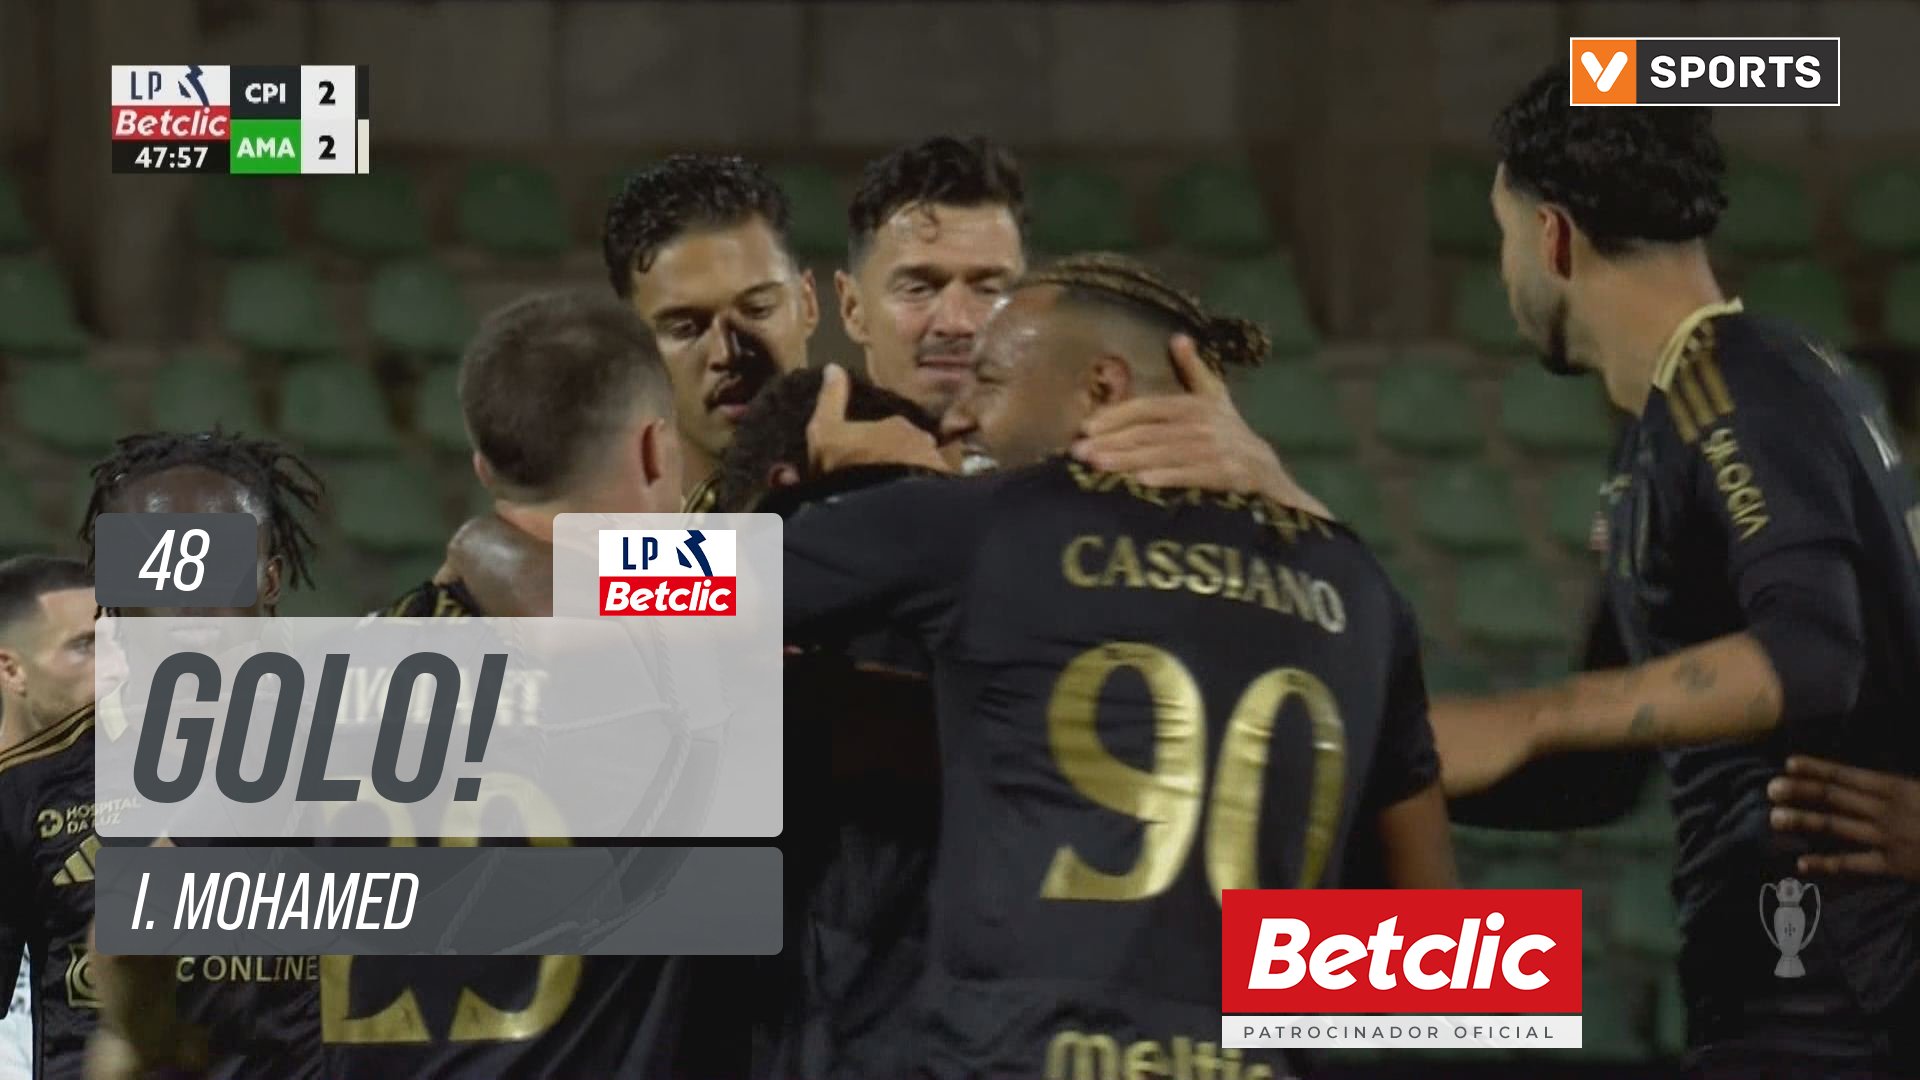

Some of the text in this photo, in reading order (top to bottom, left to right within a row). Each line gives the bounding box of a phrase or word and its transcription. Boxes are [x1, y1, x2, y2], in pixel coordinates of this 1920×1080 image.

[1061, 534, 1346, 635] CASSIANO
[1040, 640, 1347, 910] 90
[202, 955, 319, 982] ONLINE
